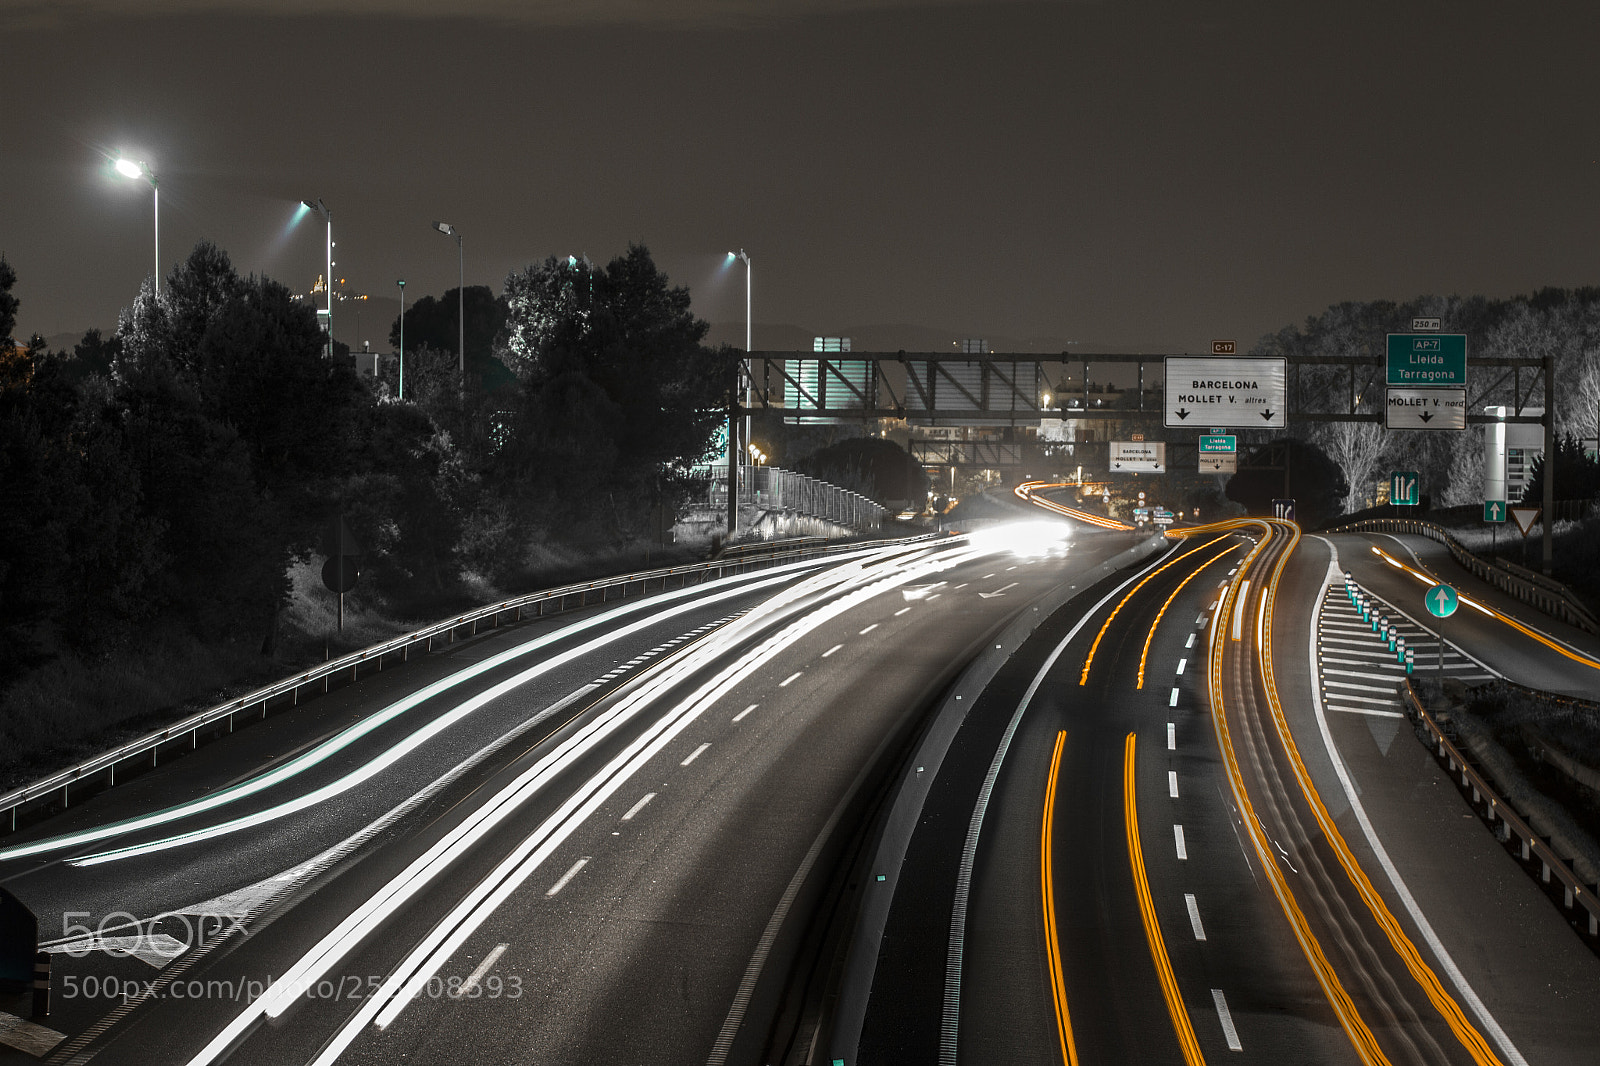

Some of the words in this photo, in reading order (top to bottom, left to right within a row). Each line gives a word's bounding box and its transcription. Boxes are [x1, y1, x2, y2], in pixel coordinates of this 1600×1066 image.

[1415, 341, 1438, 349] AP-7
[1409, 354, 1444, 364] Lleida
[1398, 369, 1455, 381] Tarragona
[1192, 381, 1258, 389] BARCELONA
[1178, 395, 1222, 403] MOLLET
[1228, 395, 1237, 404] V.
[1244, 396, 1267, 404] altres
[1388, 398, 1428, 406] MOLLET
[1432, 398, 1441, 407] V.
